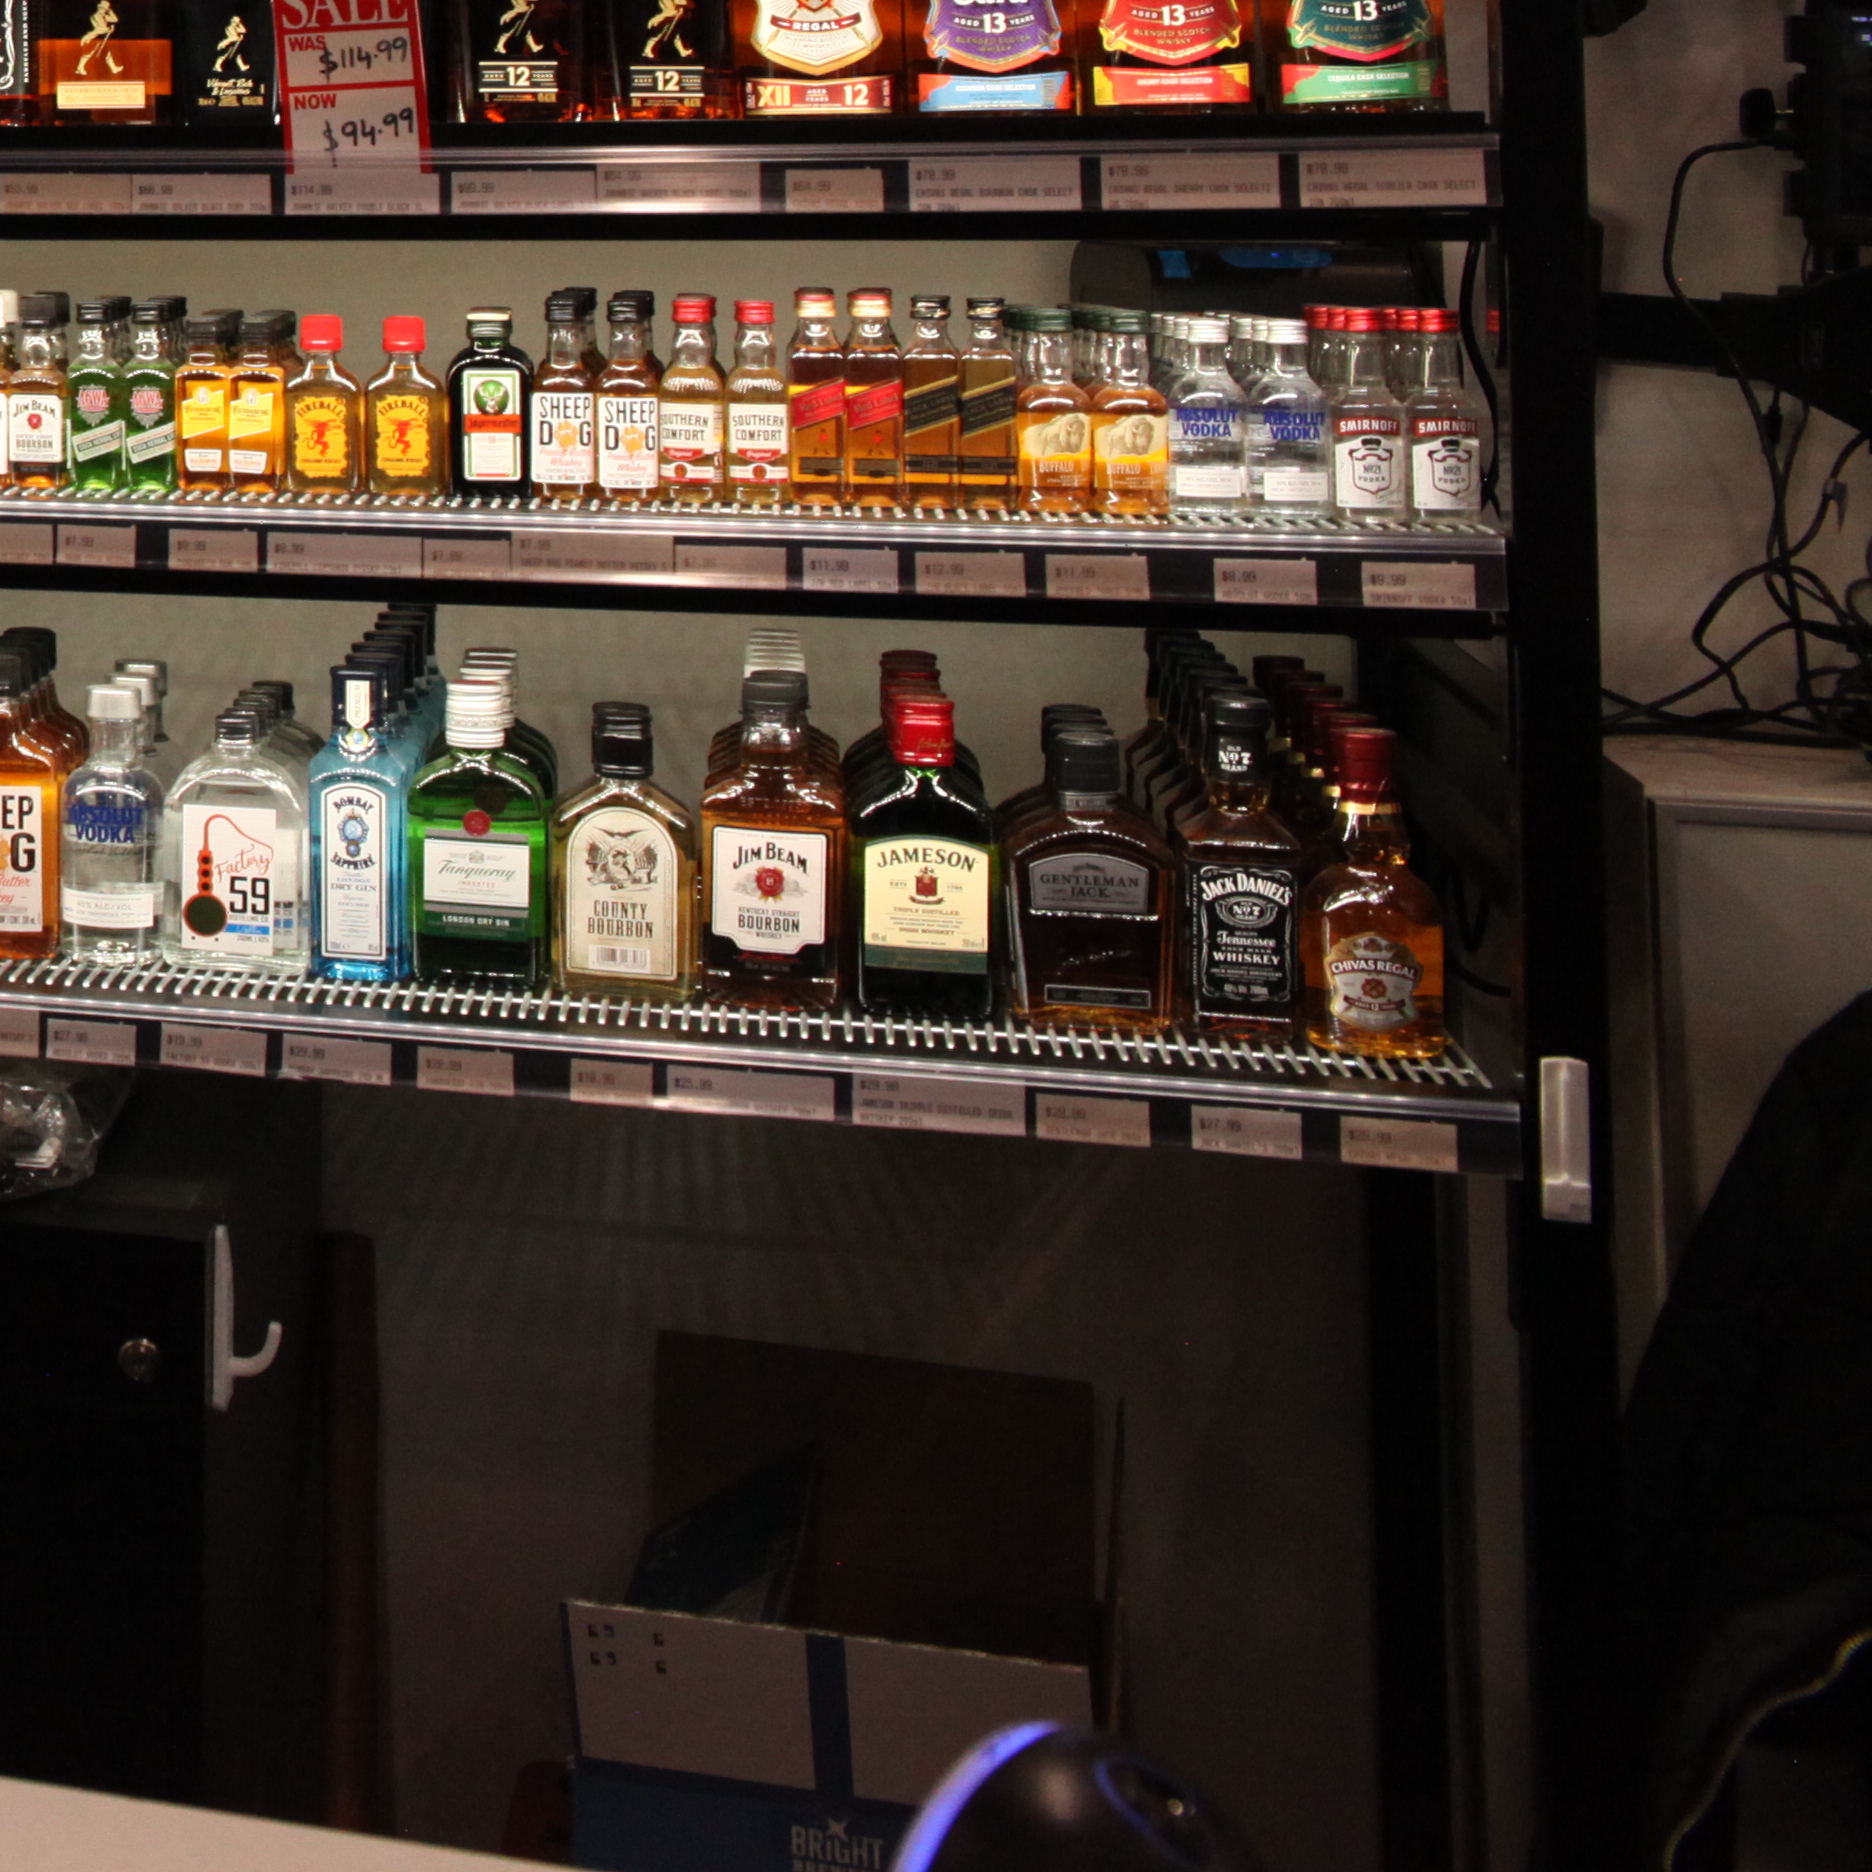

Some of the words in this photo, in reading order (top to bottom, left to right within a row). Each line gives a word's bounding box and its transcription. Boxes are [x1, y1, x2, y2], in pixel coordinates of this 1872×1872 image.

[1161, 4, 1186, 25] 13
[1352, 1, 1379, 21] 13
[506, 67, 531, 86] 12
[655, 71, 680, 91] 12
[540, 397, 591, 419] SHEEP
[604, 400, 655, 422] SHEEP
[732, 414, 784, 428] SOUTHERN
[1181, 423, 1232, 437] VODKA
[1339, 418, 1399, 433] SMIRNOFF
[1418, 420, 1477, 435] SMIRNOFF
[735, 429, 782, 442] COMFORT
[1271, 426, 1321, 441] VODKA
[333, 795, 375, 813] BOMBAY
[74, 826, 135, 843] VODKA
[329, 854, 377, 870] SAPPHIRE
[732, 844, 763, 870] JIM
[764, 842, 808, 873] BEAM
[876, 847, 976, 873] JAMESON
[1039, 873, 1140, 888] GENTLEMAN
[1199, 879, 1236, 901] JACK
[1236, 873, 1294, 907] DANIEL'S
[228, 877, 270, 915] 59
[593, 899, 648, 920] COUNTY
[587, 917, 654, 940] BOURBON
[737, 913, 801, 934] BOURBON
[1212, 950, 1282, 966] WHISKEY
